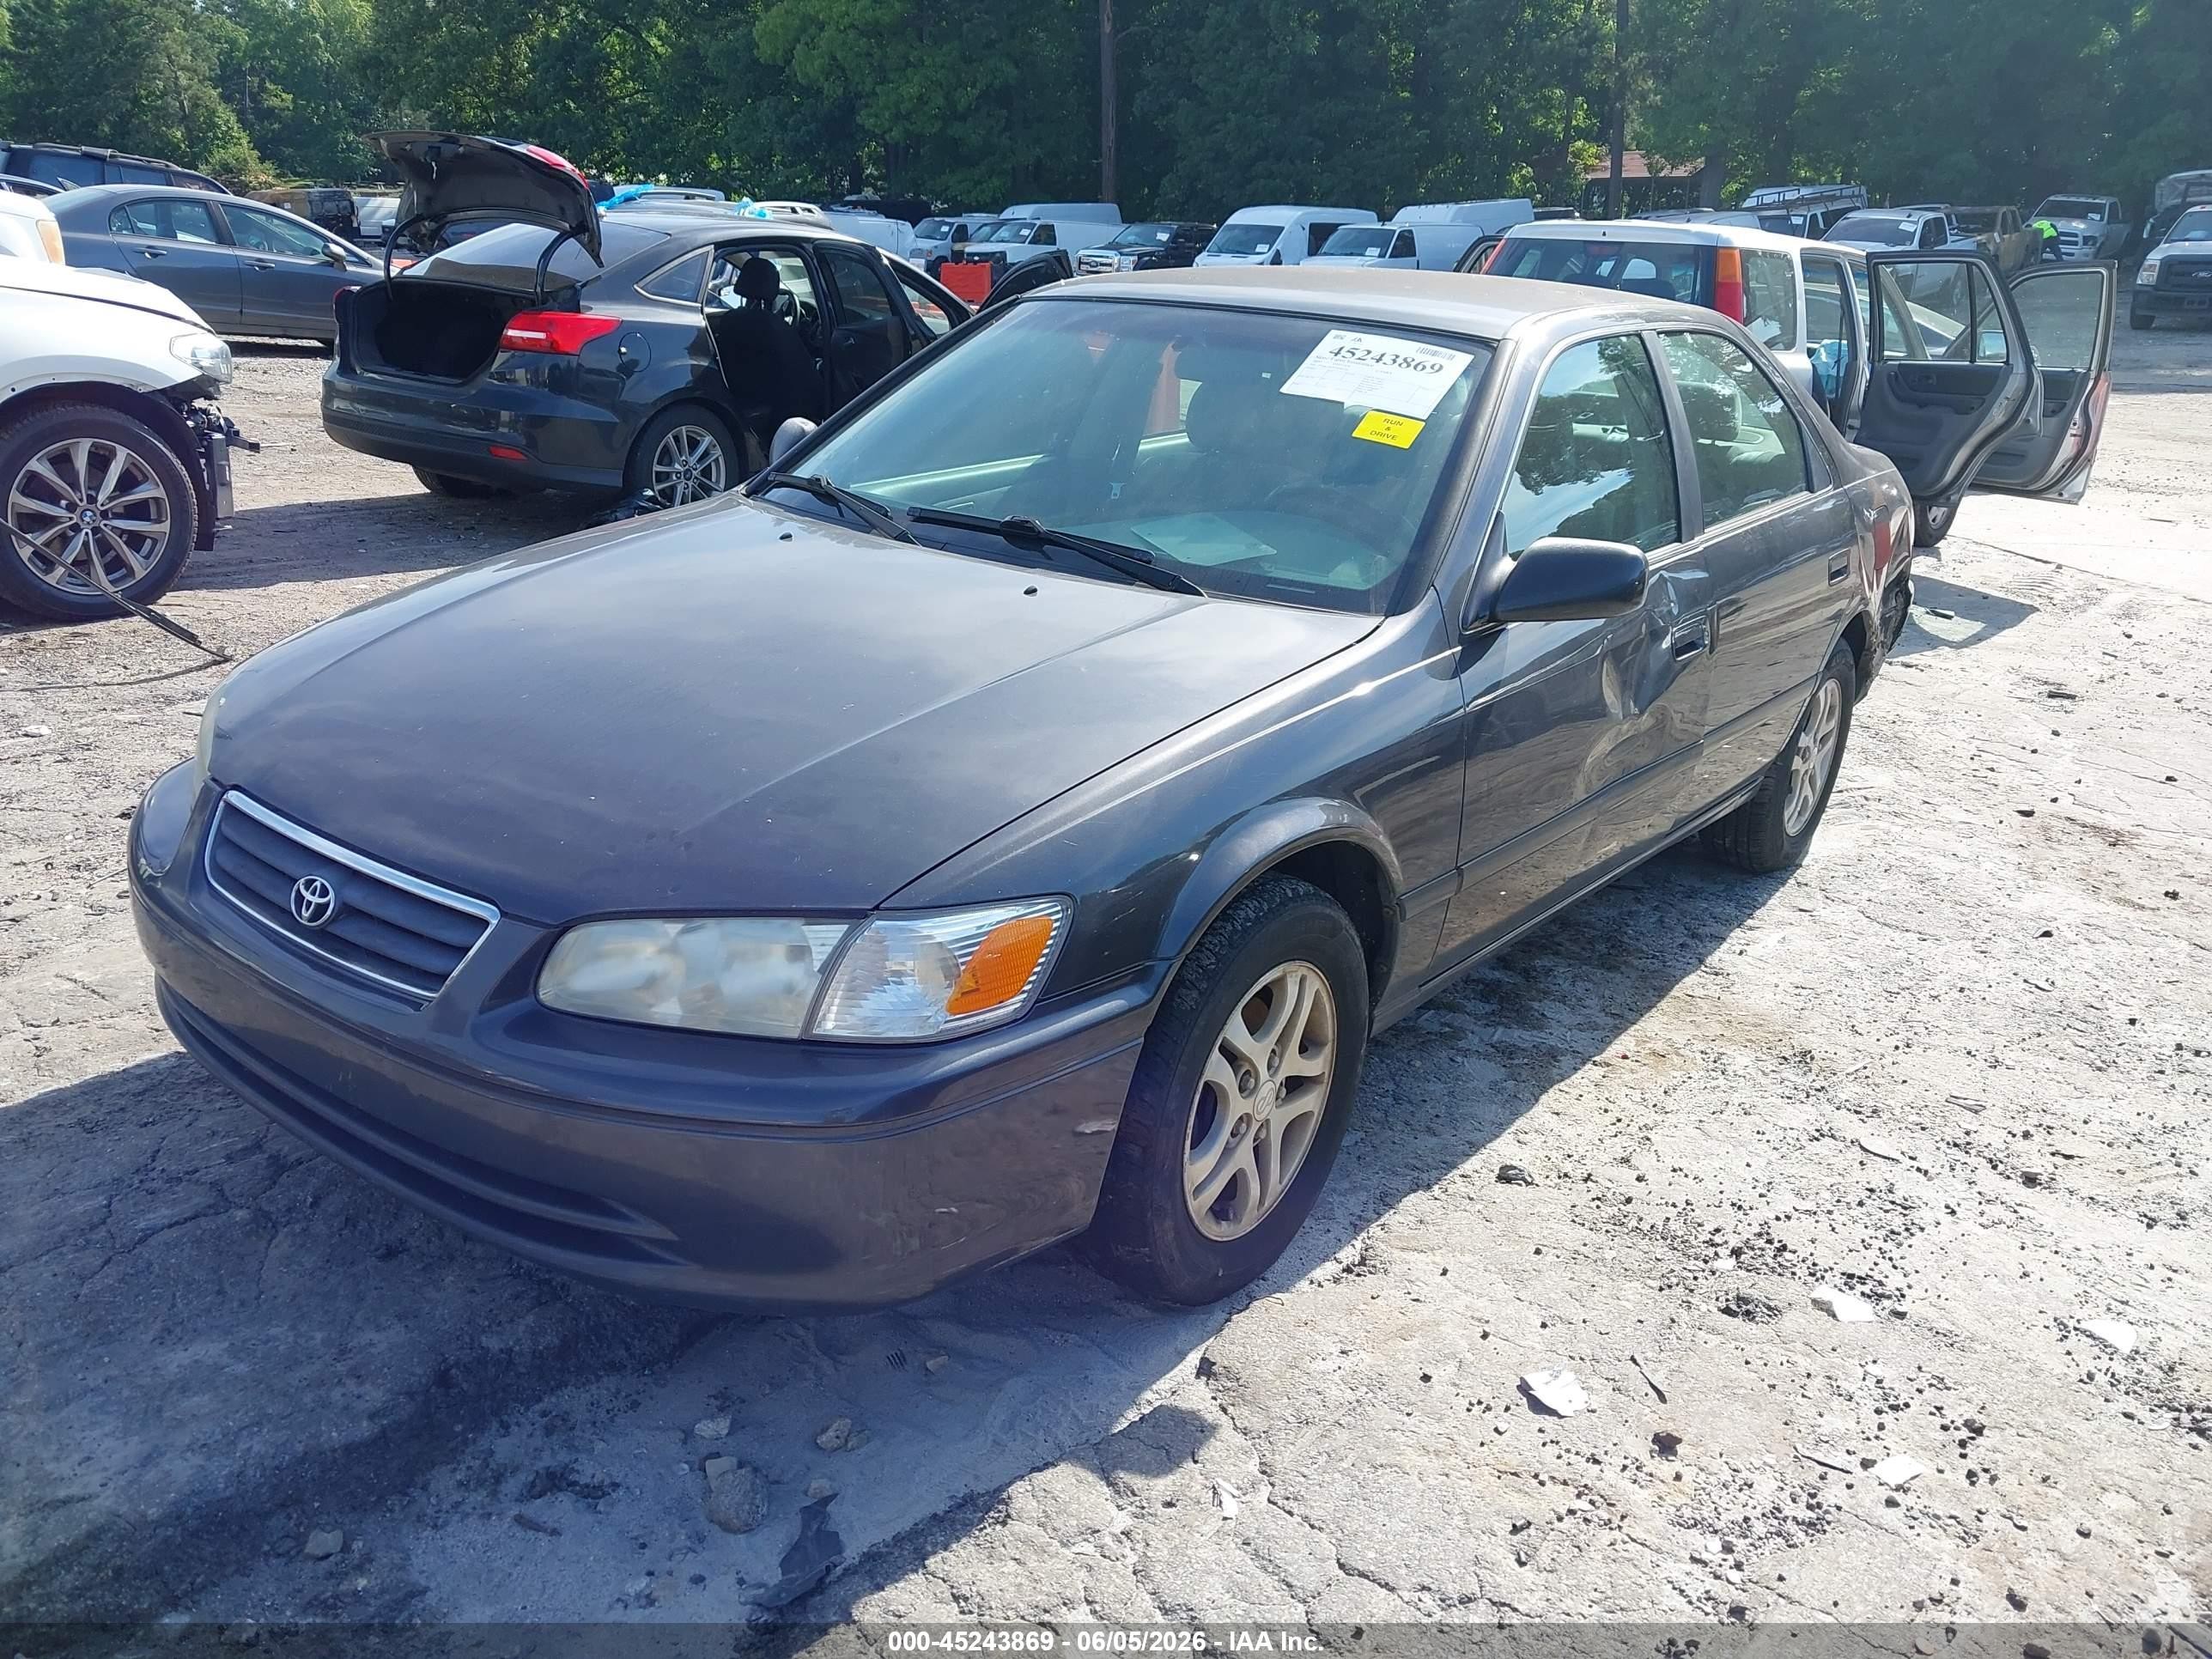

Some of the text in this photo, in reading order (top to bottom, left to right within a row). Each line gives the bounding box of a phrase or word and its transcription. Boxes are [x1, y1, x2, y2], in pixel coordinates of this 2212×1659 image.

[1328, 345, 1444, 375] 45243869
[1382, 418, 1404, 427] RUN
[1370, 429, 1398, 441] DRIVE
